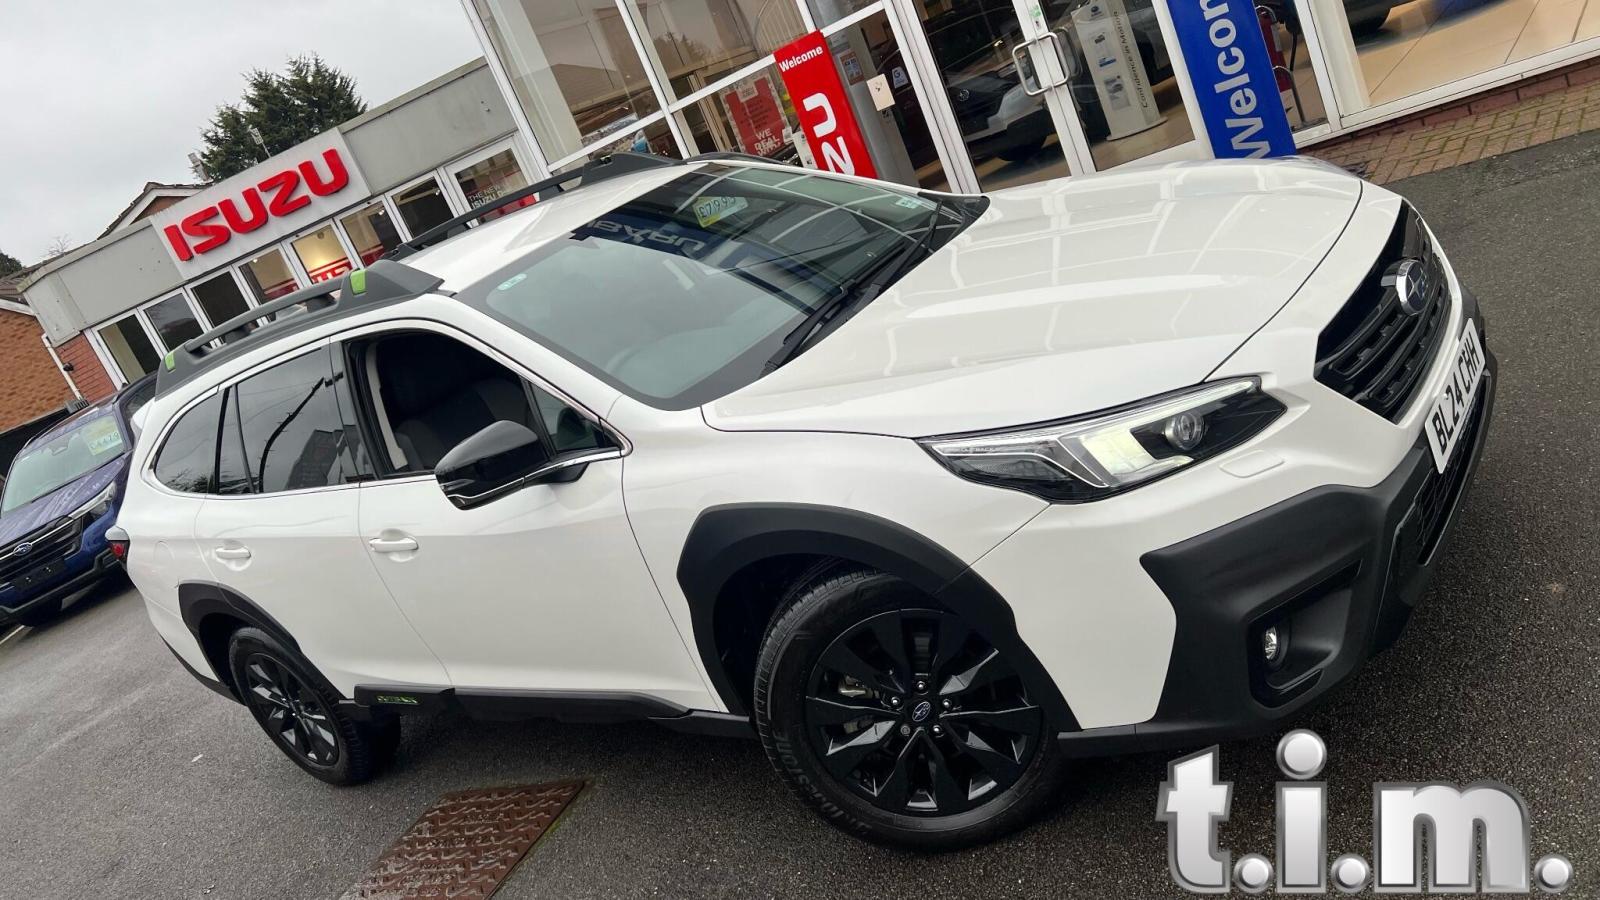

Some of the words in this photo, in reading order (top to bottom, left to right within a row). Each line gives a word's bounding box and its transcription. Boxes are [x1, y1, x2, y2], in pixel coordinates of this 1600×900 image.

[779, 46, 824, 73] Welcome
[755, 127, 772, 141] WE
[163, 148, 350, 262] ISUZU
[1432, 371, 1465, 456] BL24
[1458, 331, 1480, 394] CHH
